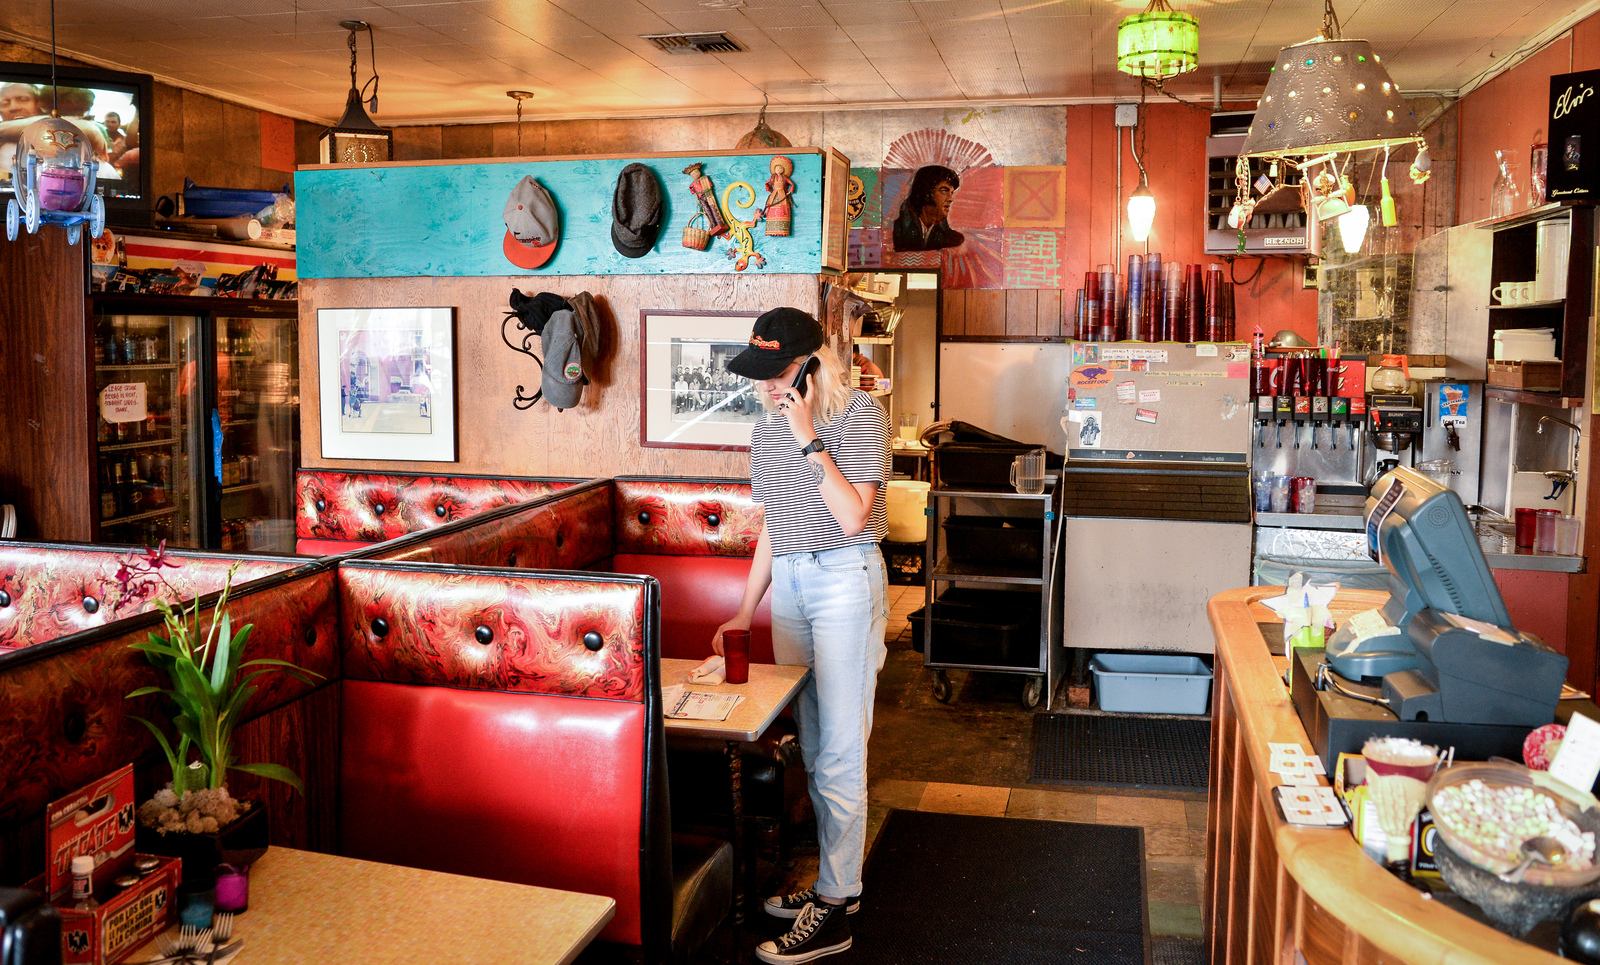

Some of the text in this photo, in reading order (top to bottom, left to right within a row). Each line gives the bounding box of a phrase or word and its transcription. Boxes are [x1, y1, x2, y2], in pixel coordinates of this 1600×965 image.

[1553, 82, 1594, 119] Elvis
[53, 814, 116, 877] TECATE
[109, 894, 152, 929] POR LOS QUE
[115, 934, 123, 946] LA
[124, 915, 153, 939] COMIDA
